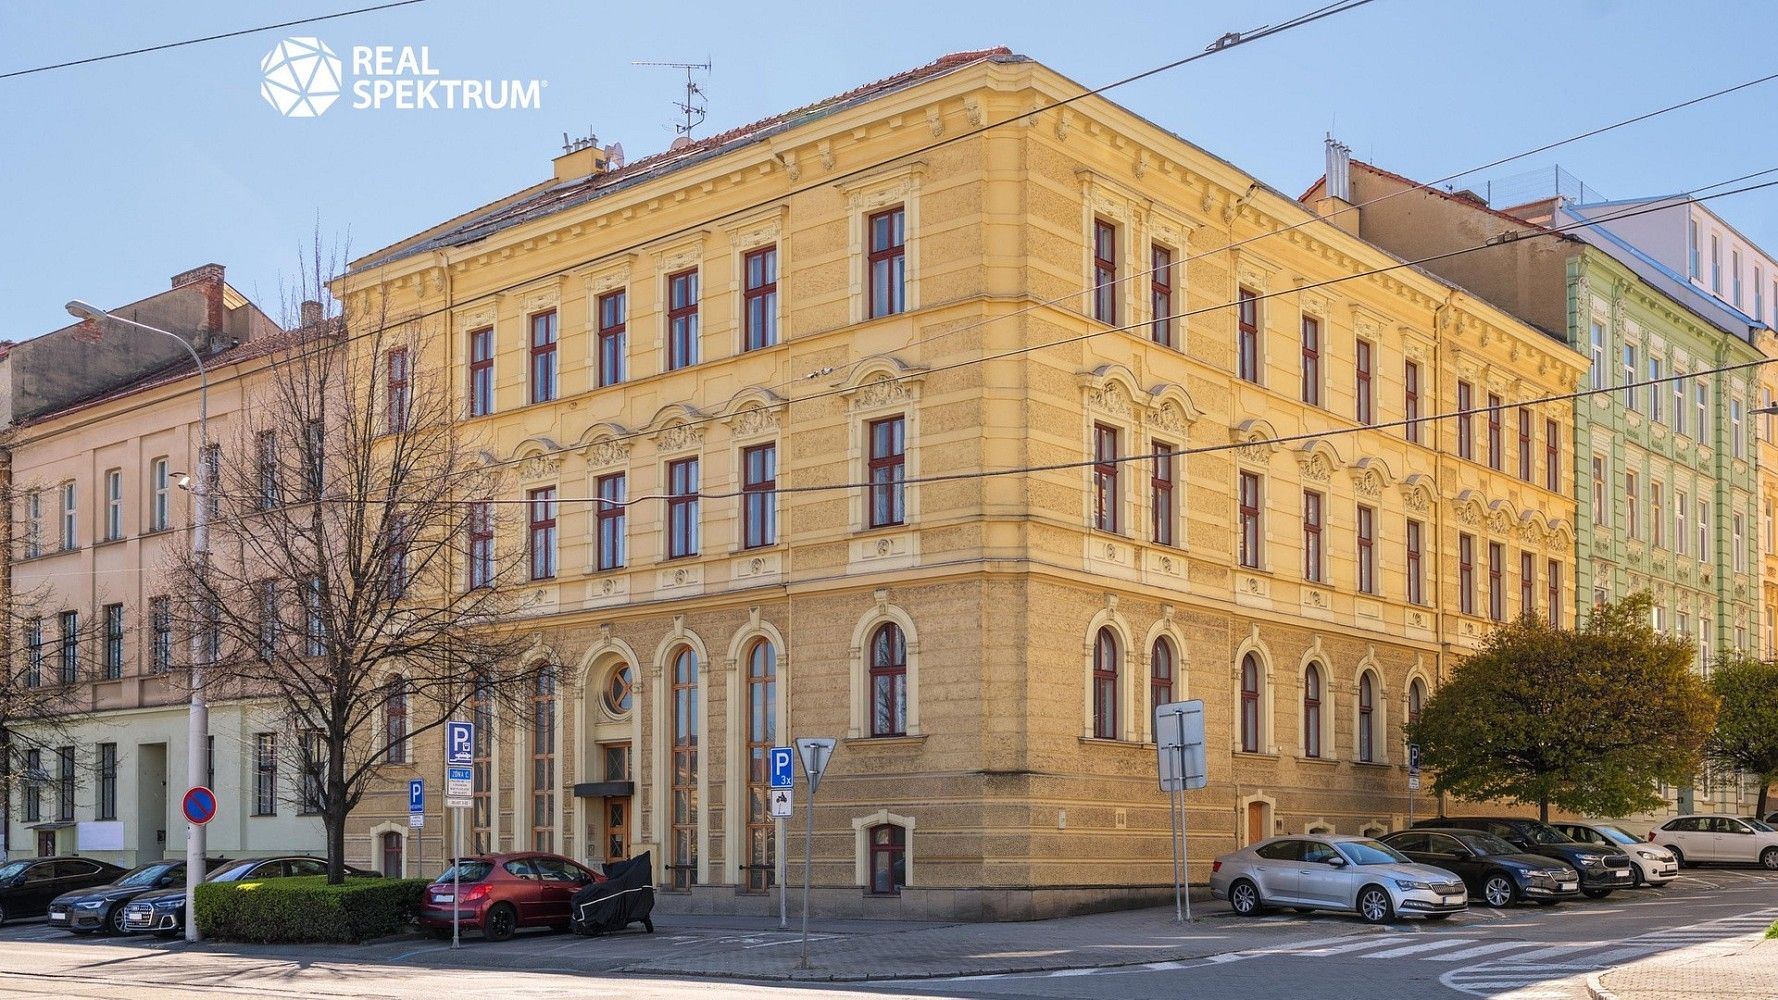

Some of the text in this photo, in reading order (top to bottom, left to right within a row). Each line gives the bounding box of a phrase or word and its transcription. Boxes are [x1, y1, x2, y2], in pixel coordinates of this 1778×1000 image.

[454, 727, 469, 751] P
[776, 752, 789, 775] P
[1412, 747, 1418, 766] P
[781, 775, 792, 785] 3x
[413, 784, 421, 803] P
